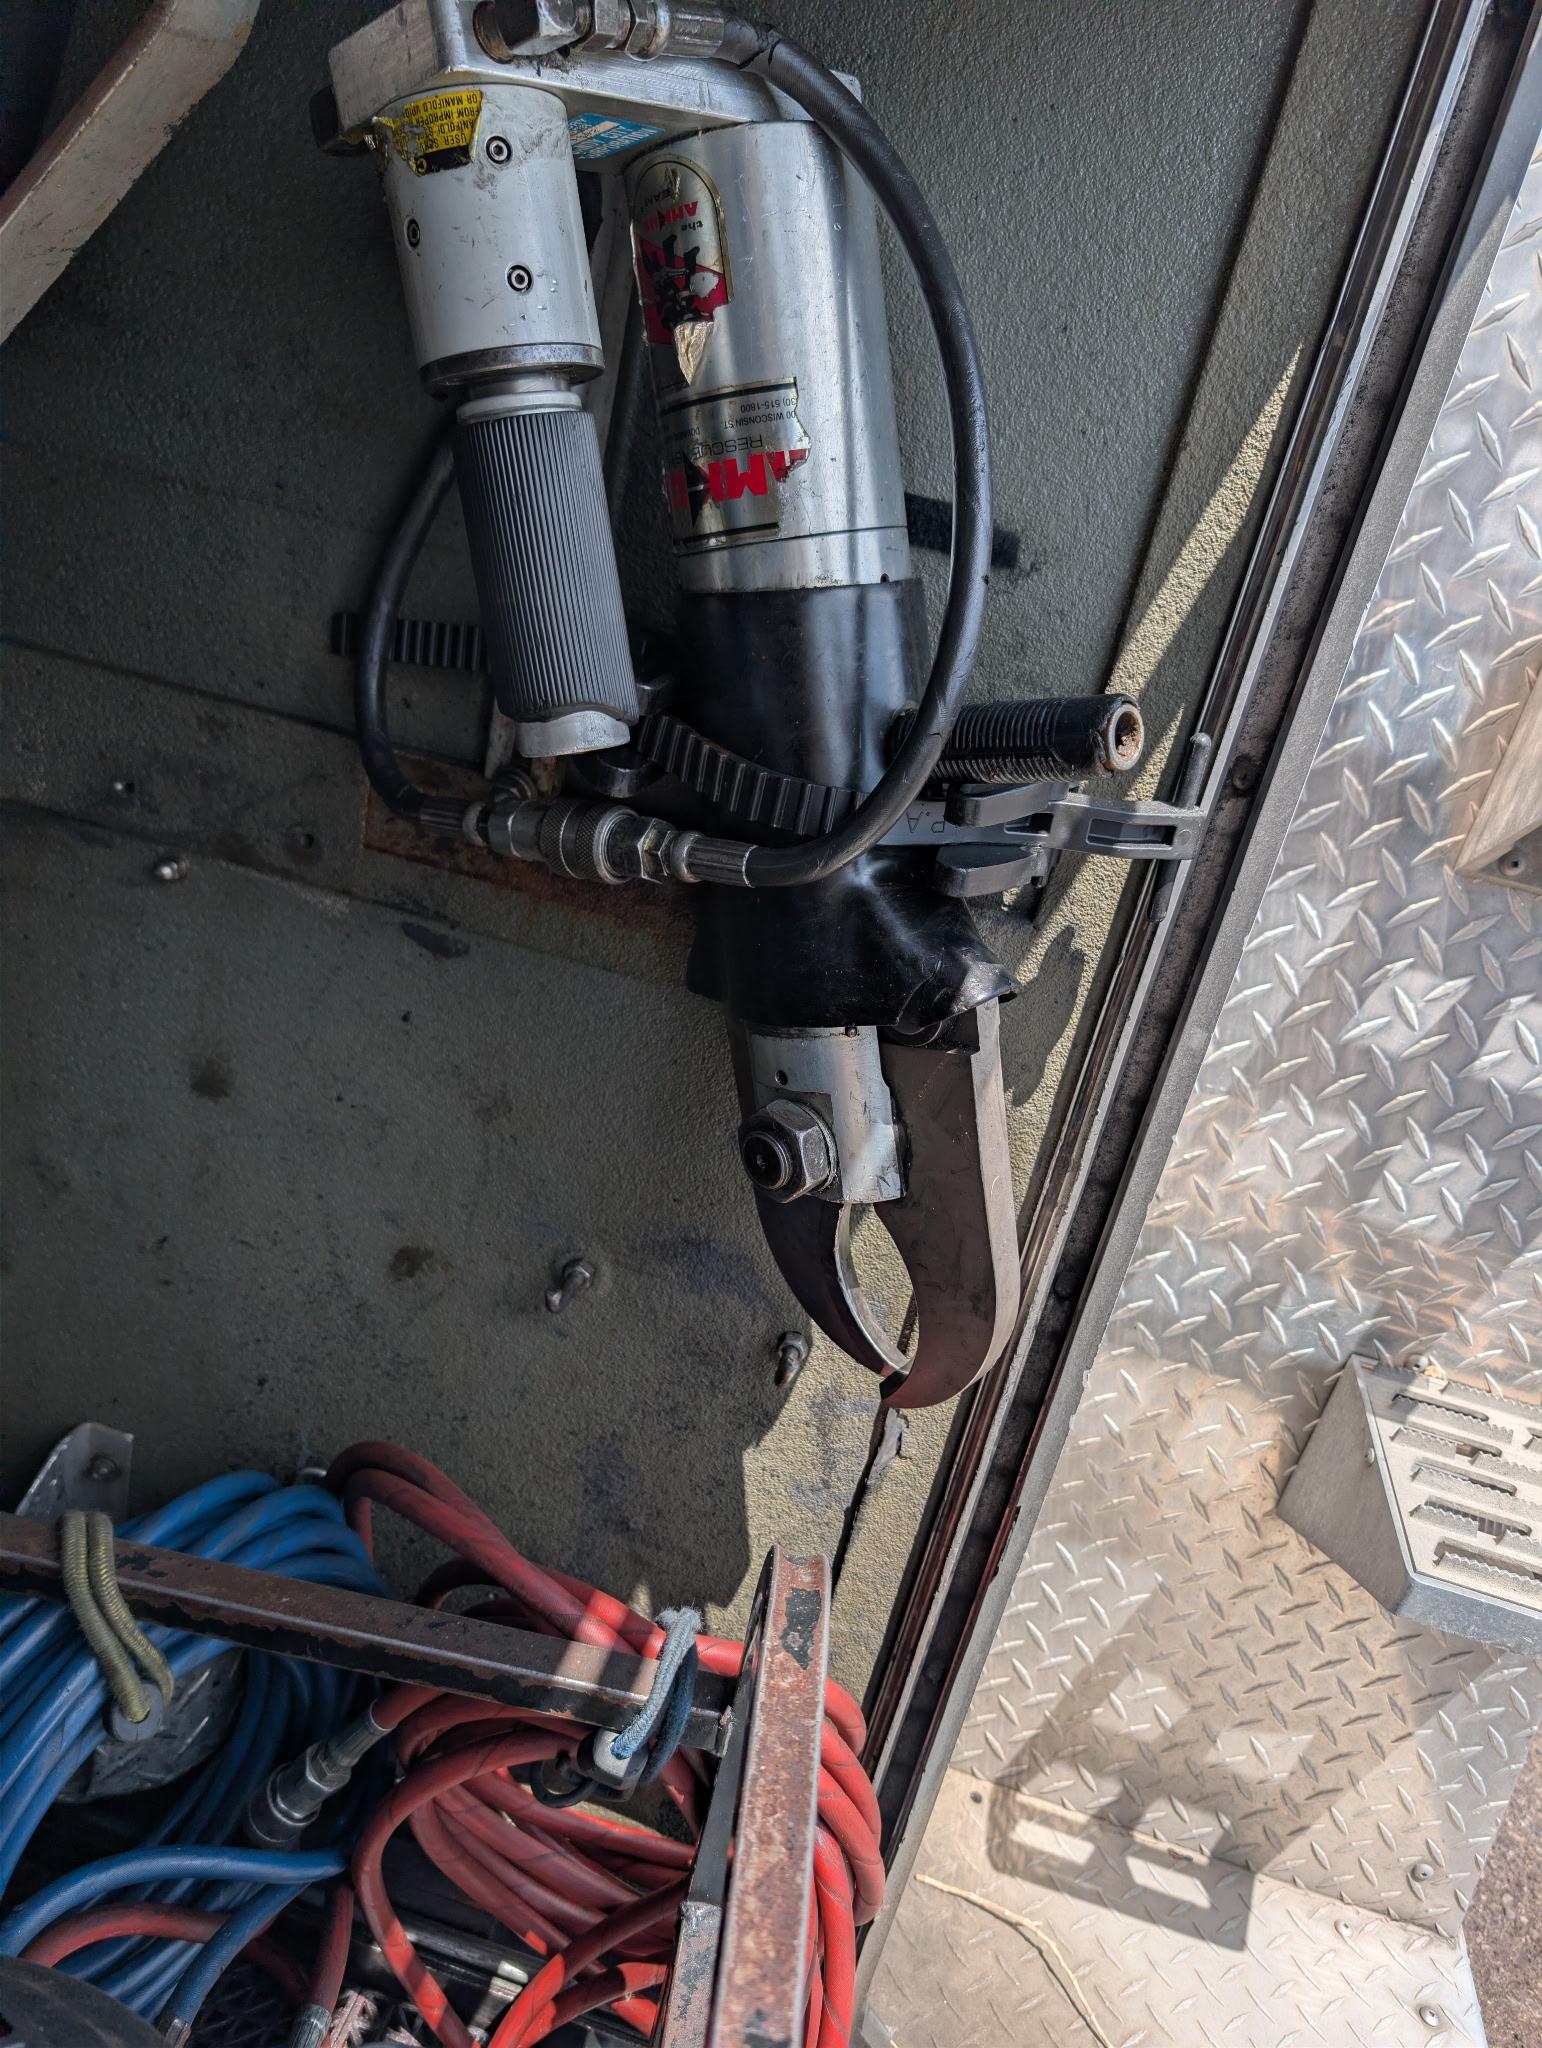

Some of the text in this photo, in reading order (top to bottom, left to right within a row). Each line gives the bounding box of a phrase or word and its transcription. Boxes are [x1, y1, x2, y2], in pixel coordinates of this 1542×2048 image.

[423, 96, 463, 112] MANIFOLD
[467, 93, 478, 104] OR
[416, 107, 480, 127] FROM IMPROPER
[438, 120, 474, 134] ANIFOLD!
[443, 133, 466, 146] USER
[644, 188, 672, 207] EAM
[681, 221, 703, 231] the
[740, 399, 780, 411] 515-1800
[735, 413, 785, 426] WISCONSIN
